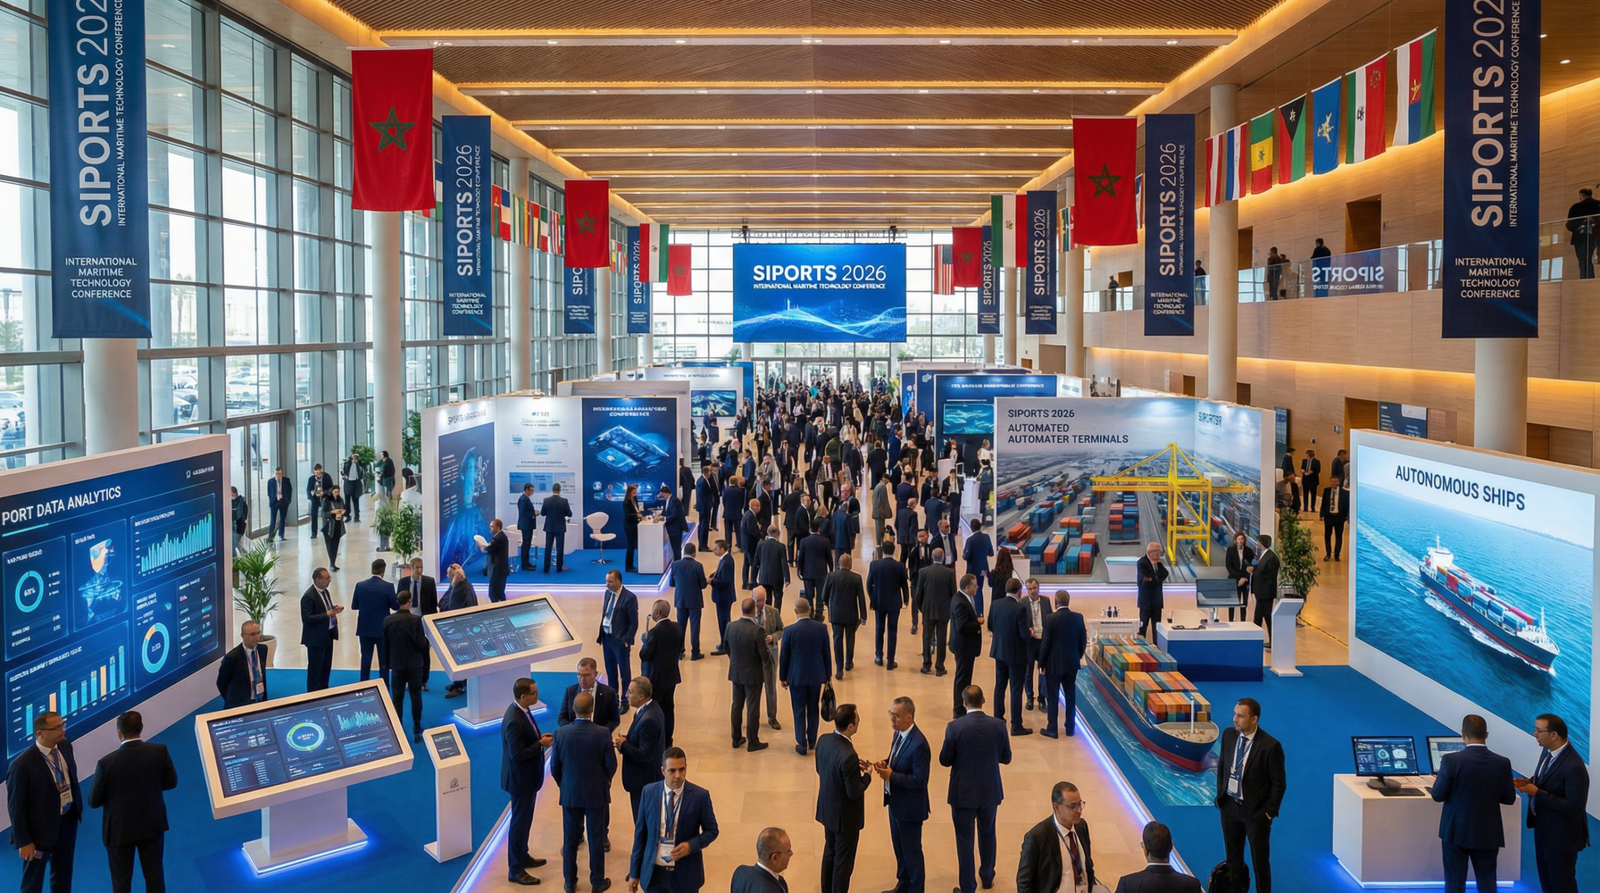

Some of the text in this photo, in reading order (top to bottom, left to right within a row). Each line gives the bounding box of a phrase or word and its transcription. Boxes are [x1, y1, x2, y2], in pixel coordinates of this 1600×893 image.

[1510, 59, 1520, 118] TECHNOLOGY
[114, 0, 126, 227] INTERNATIONAL MARITIME TECHNOLOGY CONFERENC
[77, 63, 112, 227] SIPORTS
[1471, 65, 1505, 228] SIPORTS
[1510, 118, 1519, 162] MARITIME
[1159, 142, 1176, 277] SIPORTS 2026
[1509, 163, 1518, 228] INTERNATIONAL
[456, 144, 474, 277] SIPORTS 2026
[1033, 208, 1046, 237] 2026
[65, 257, 138, 267] INTERNATIONAL
[78, 268, 124, 278] MARITIME
[753, 265, 886, 281] SIPORTS 2026
[1034, 239, 1045, 296] SIPORTS
[1455, 257, 1527, 267] INTERNATIONAL
[1468, 268, 1514, 278] MARITIME
[70, 278, 132, 289] TECHNOLOGY
[71, 289, 132, 300] CONFERENCE
[982, 263, 992, 305] SIPORTS
[1460, 278, 1521, 289] TECHNOLOGY
[1460, 289, 1521, 300] CONFERENCE
[1007, 423, 1070, 433] AUTOMATED
[1008, 409, 1075, 418] SIPORTS 2026
[1007, 434, 1129, 444] AUTOMATER TERMINALS
[1395, 465, 1525, 511] AUTONOMOUS SHIPS
[2, 485, 121, 526] PORT DATA ANALYTICS
